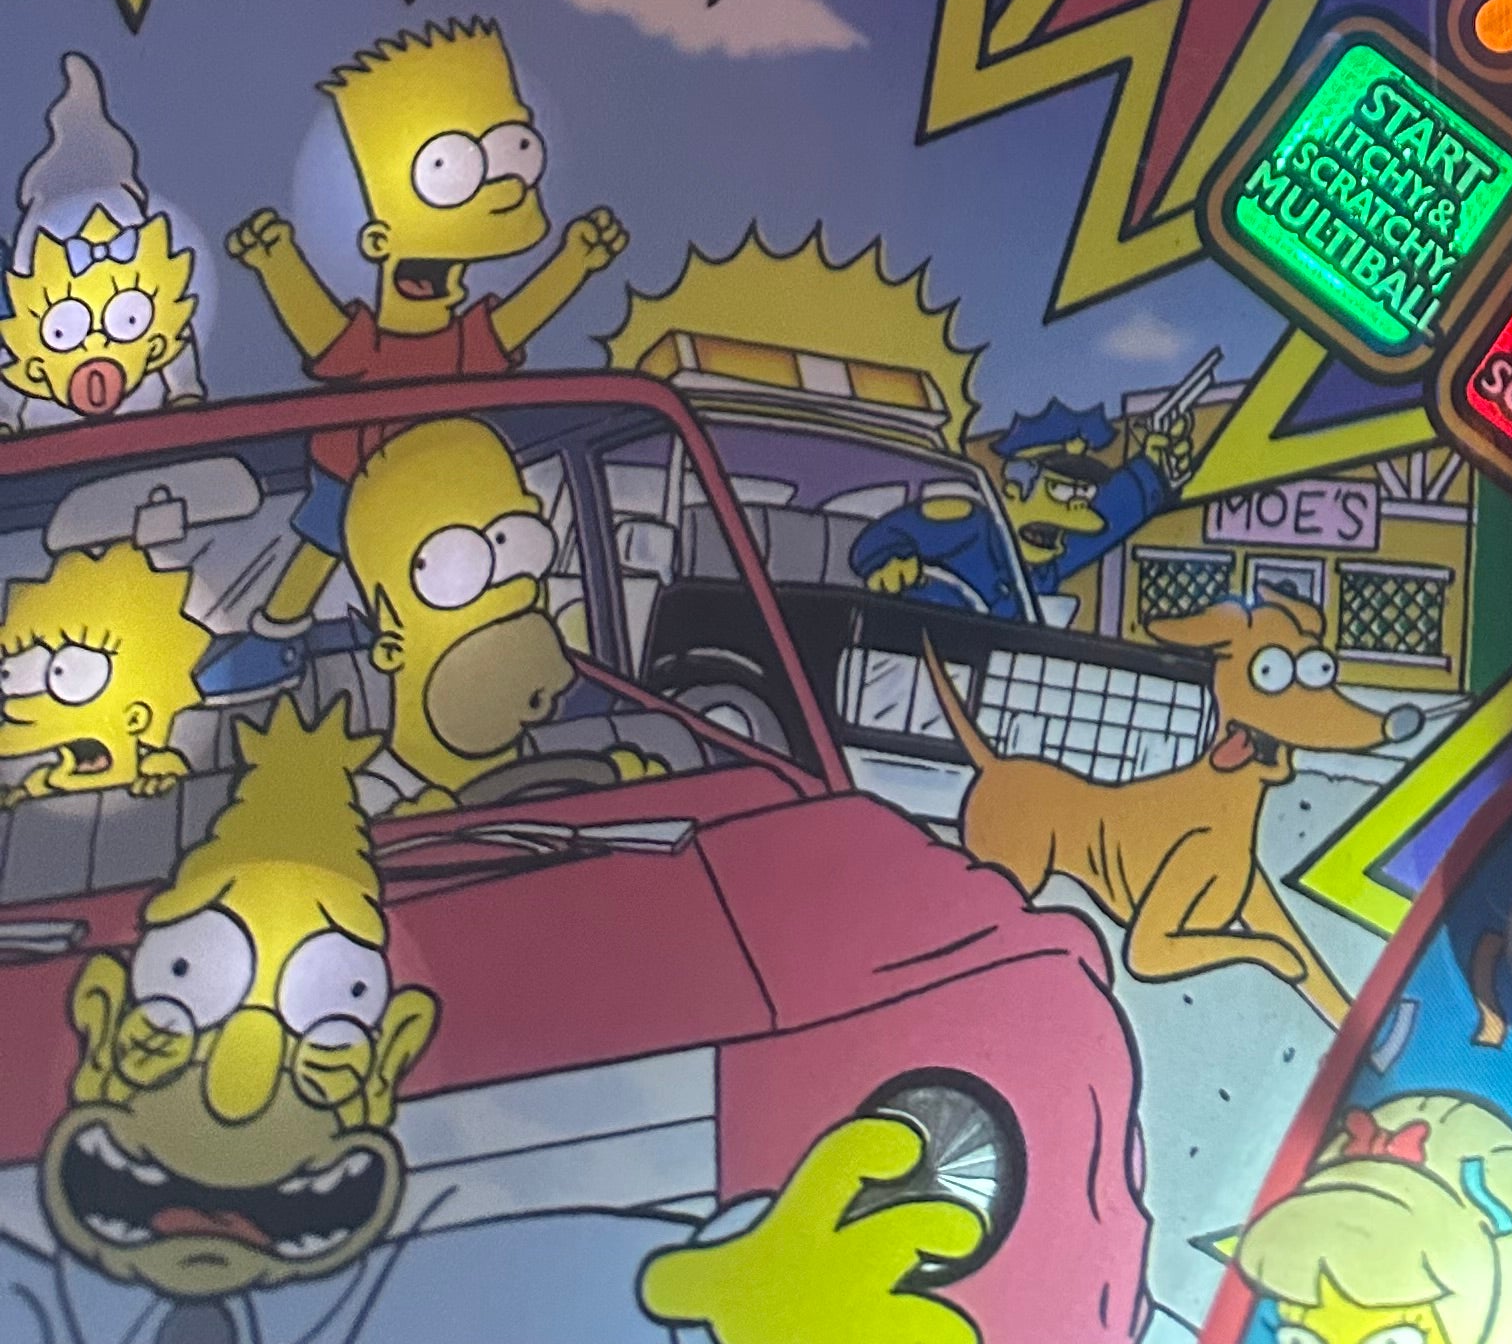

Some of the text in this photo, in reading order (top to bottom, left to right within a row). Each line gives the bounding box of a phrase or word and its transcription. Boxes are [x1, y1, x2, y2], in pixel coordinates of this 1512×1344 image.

[1334, 120, 1456, 236] ITCHY &
[1361, 83, 1493, 194] START
[1244, 159, 1441, 337] MULTIBALL
[1292, 141, 1458, 279] SCRATCHY
[1215, 486, 1369, 541] MOE'S
